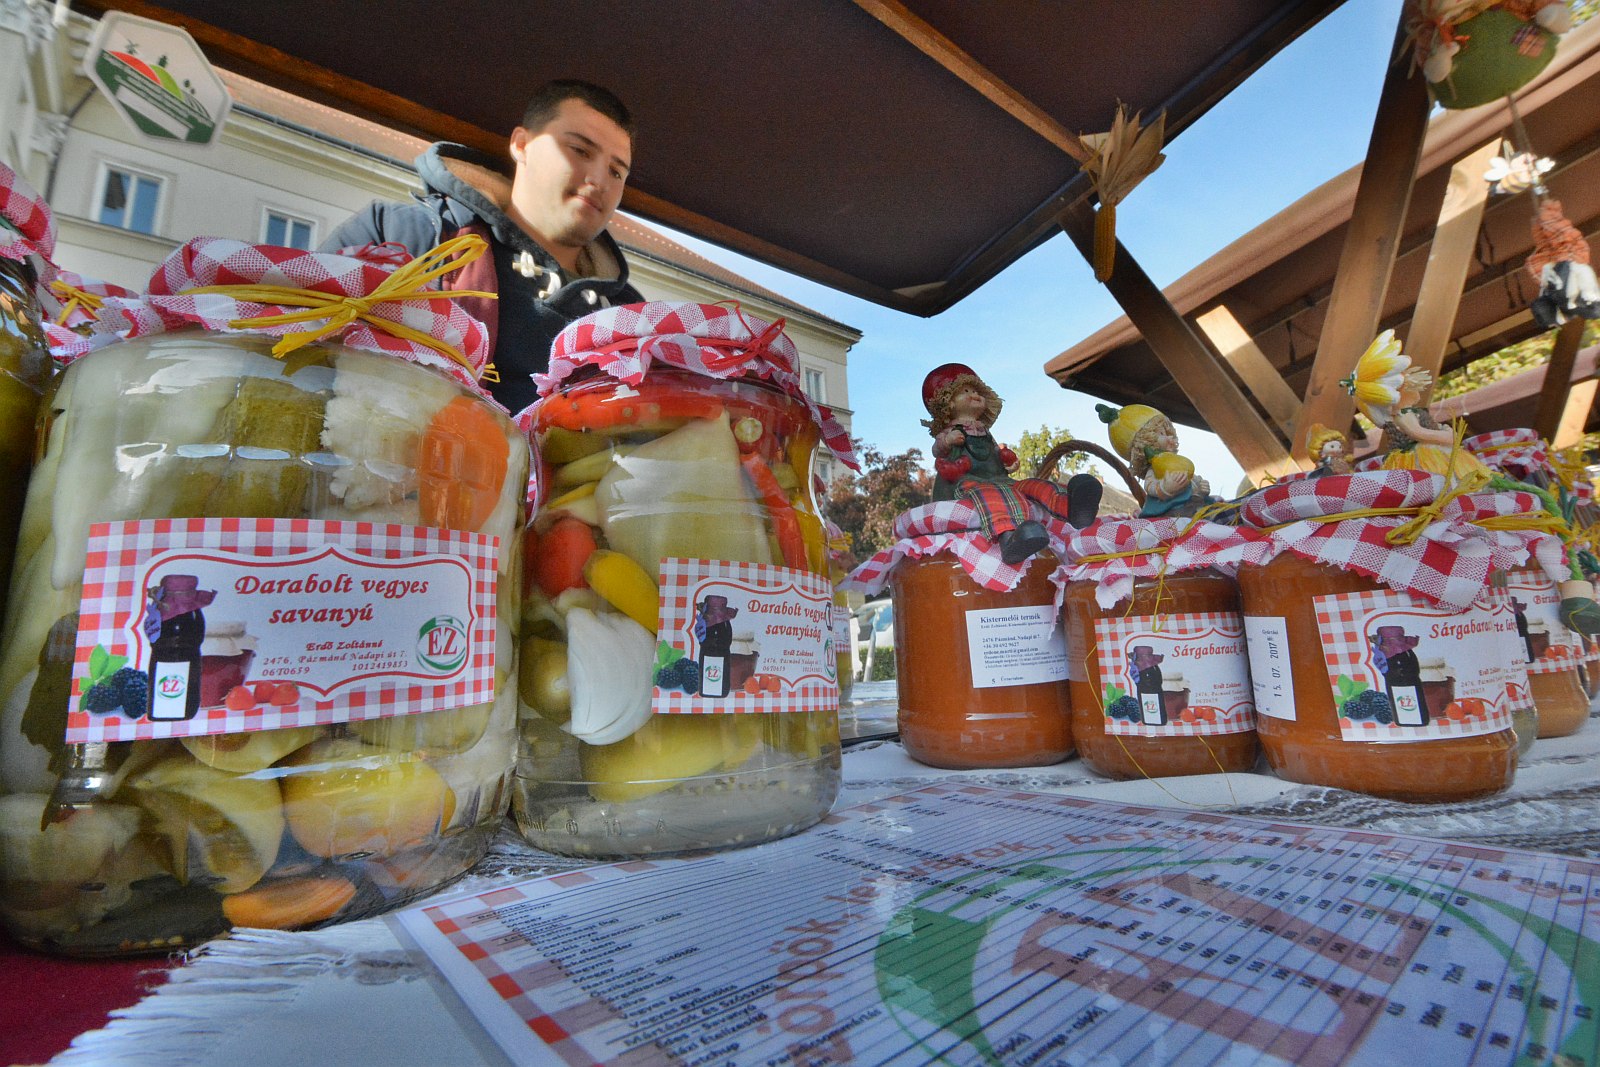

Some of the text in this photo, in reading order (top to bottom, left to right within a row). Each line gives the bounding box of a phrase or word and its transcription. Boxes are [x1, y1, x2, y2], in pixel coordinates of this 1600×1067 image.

[234, 574, 429, 599] Darabolt vegyes
[269, 603, 373, 627] savanyú
[748, 599, 802, 616] Darabolt
[980, 614, 1019, 623] Kistermelői
[426, 627, 457, 656] EZ
[766, 625, 821, 642] savanyúság
[306, 640, 383, 651] Erdő Zoltánné
[1269, 641, 1279, 659] 2017
[298, 652, 348, 663] Pázmánd
[349, 650, 384, 661] Nadapi
